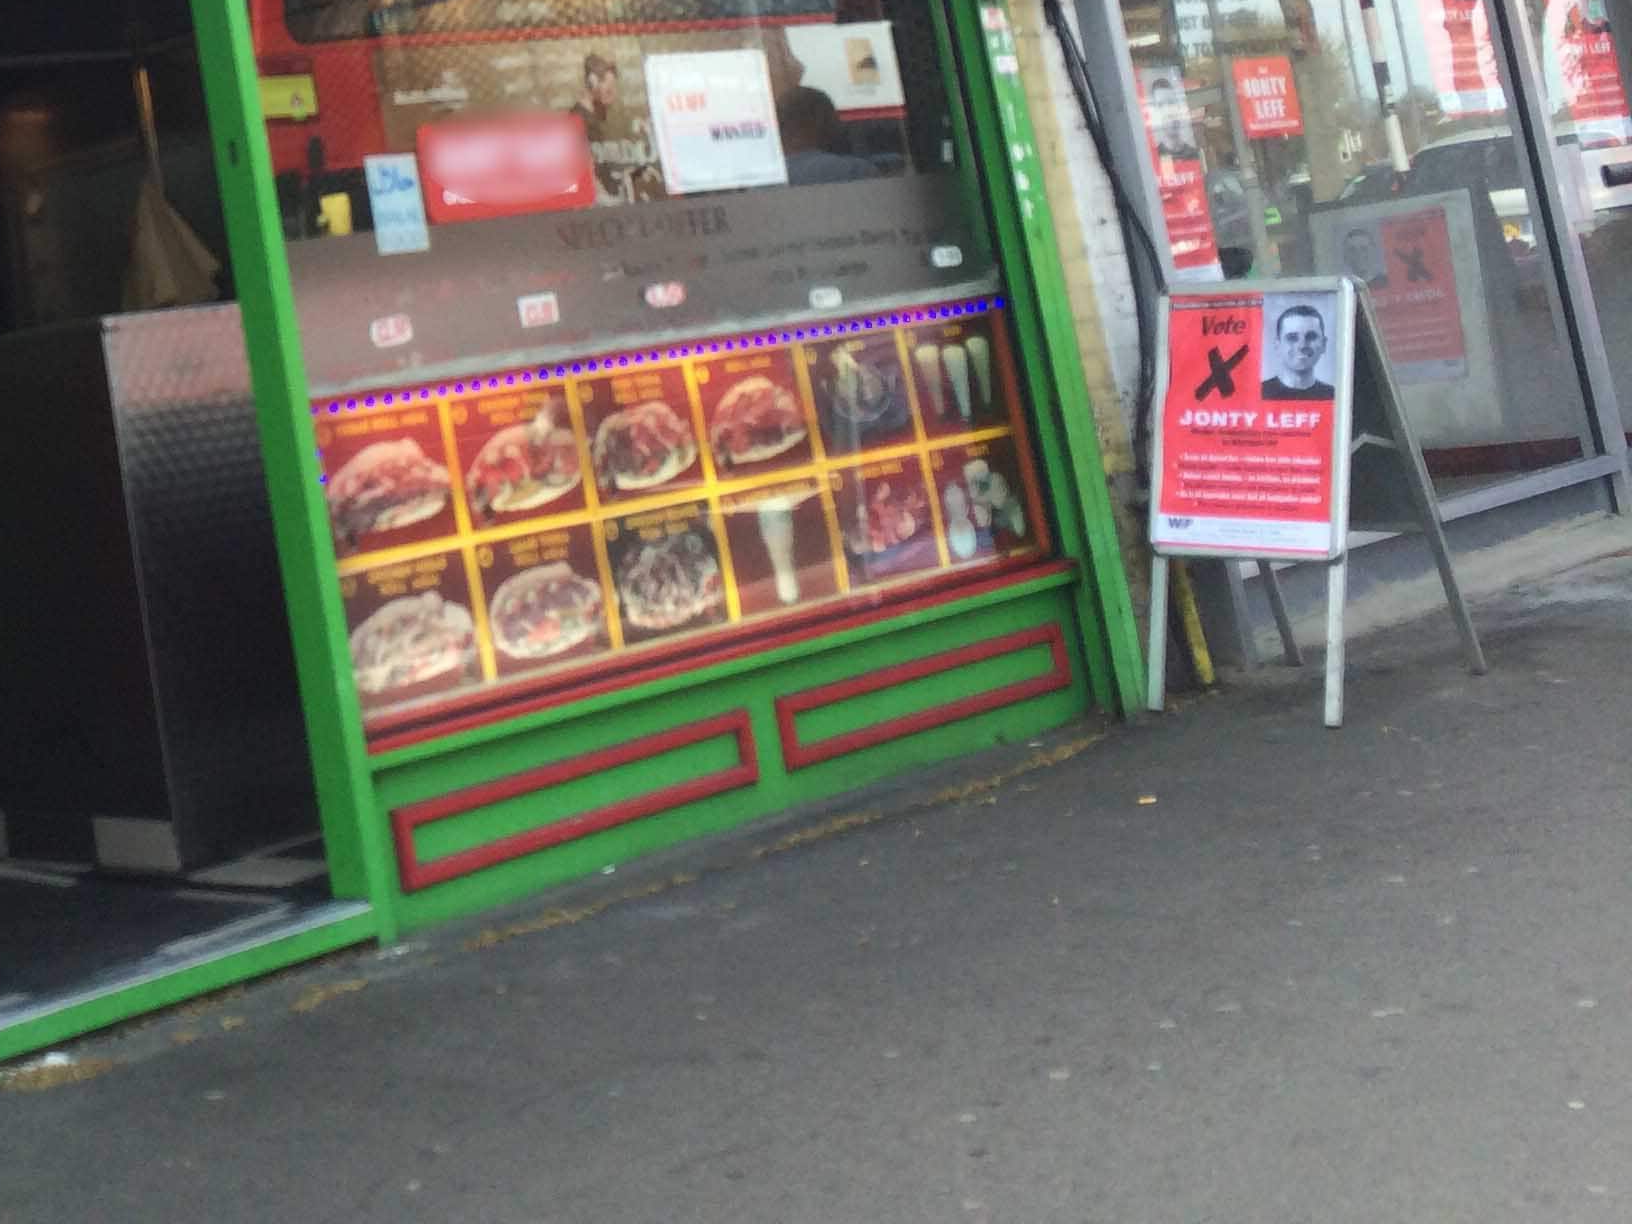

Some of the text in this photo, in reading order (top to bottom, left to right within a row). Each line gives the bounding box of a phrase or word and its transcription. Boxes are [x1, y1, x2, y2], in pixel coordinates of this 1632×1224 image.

[1201, 316, 1247, 337] Vote
[1179, 409, 1322, 429] JONTY LEFF
